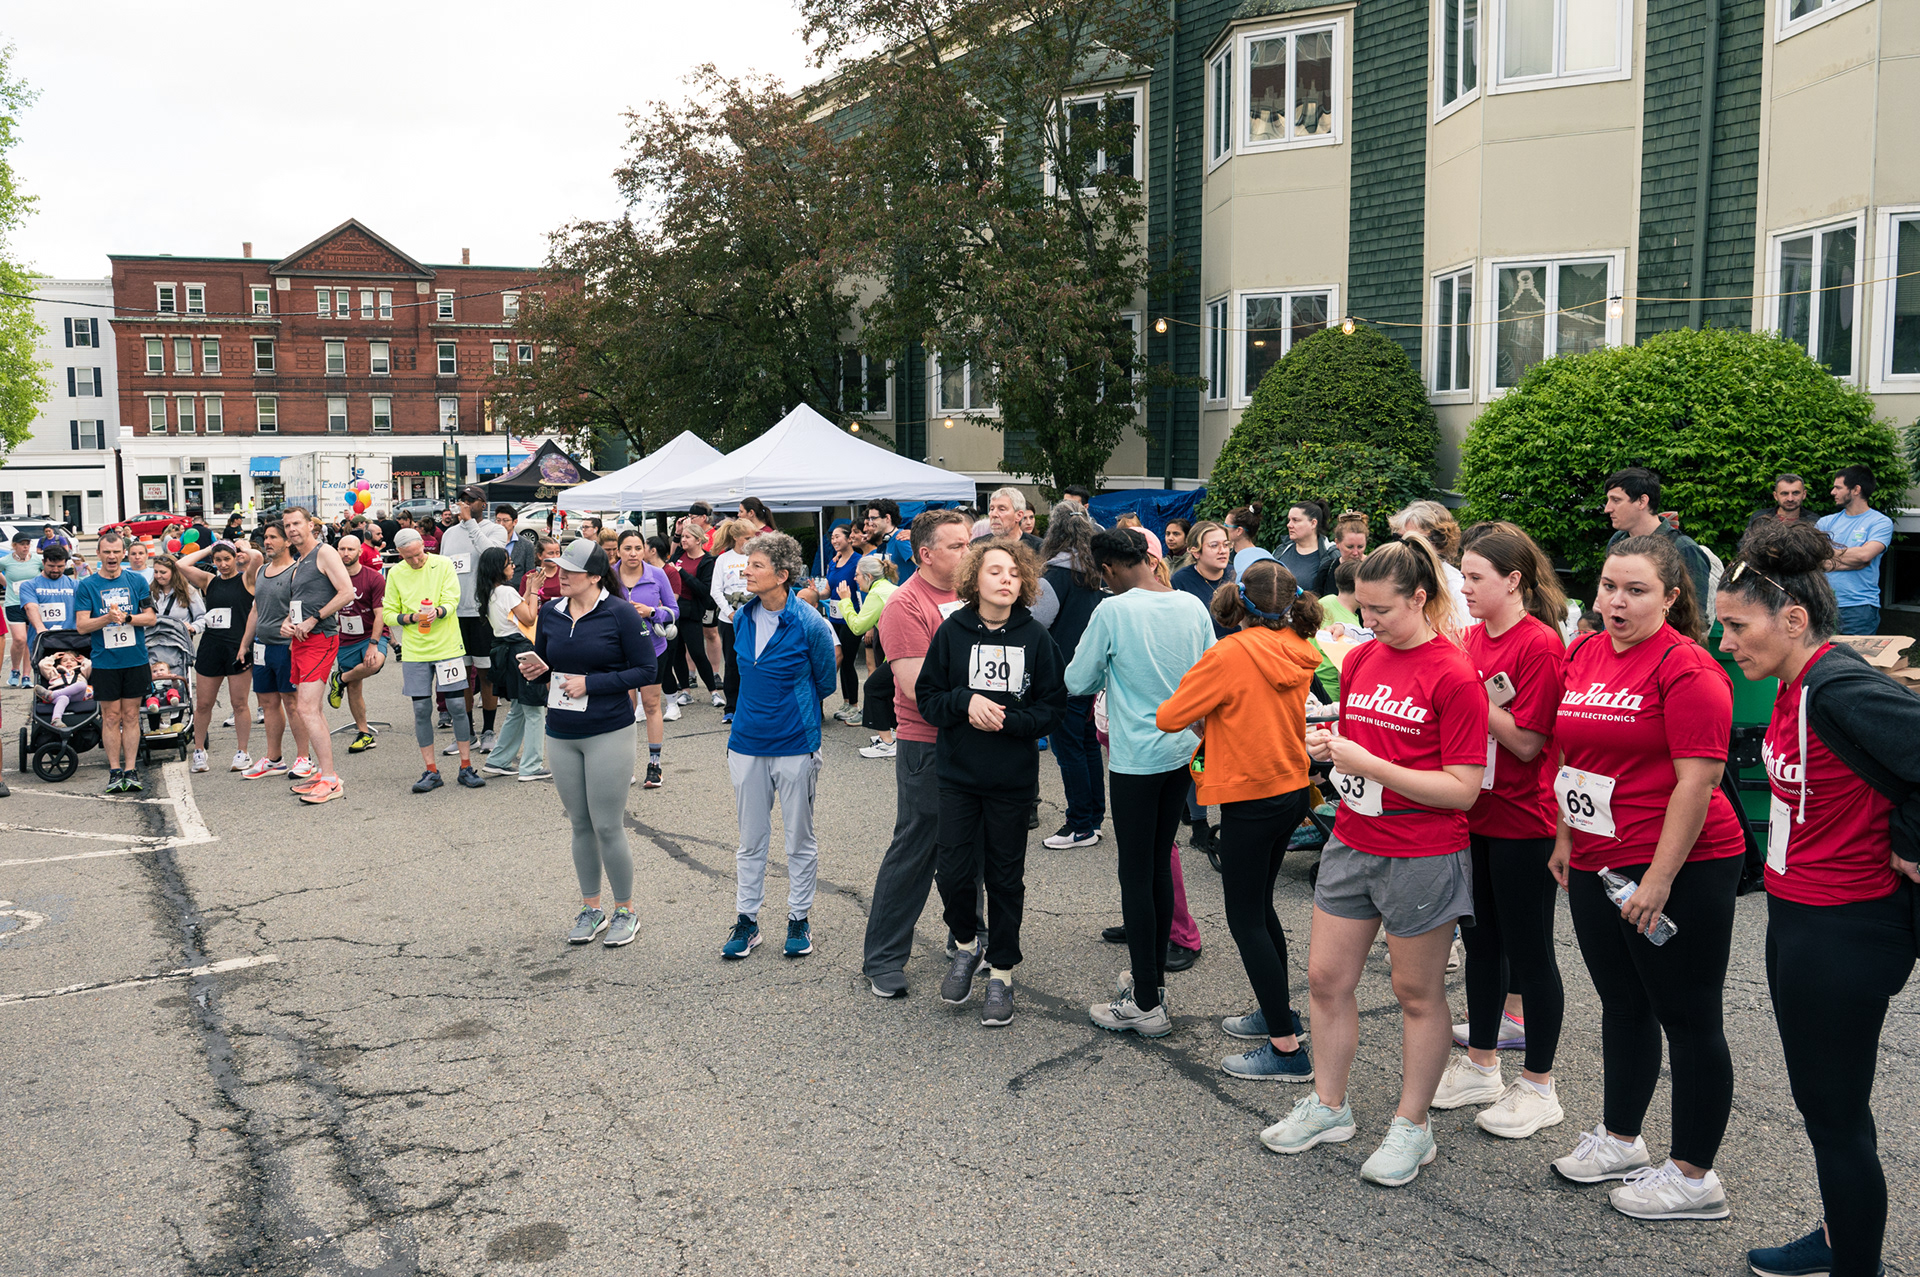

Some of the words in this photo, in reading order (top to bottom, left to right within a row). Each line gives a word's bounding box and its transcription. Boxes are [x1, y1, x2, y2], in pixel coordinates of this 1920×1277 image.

[328, 255, 378, 264] MIDDLETON
[321, 480, 347, 489] Exela
[42, 608, 62, 617] 163
[211, 614, 223, 624] 14
[347, 622, 354, 631] 9
[112, 632, 128, 643] 16
[443, 666, 459, 679] 70
[984, 660, 1011, 681] 30
[1581, 711, 1636, 723] ELECTRONICS
[1366, 717, 1374, 725] IN
[1374, 718, 1421, 736] ELECTRONICS
[1340, 774, 1365, 799] 53
[1566, 789, 1596, 818] 63
